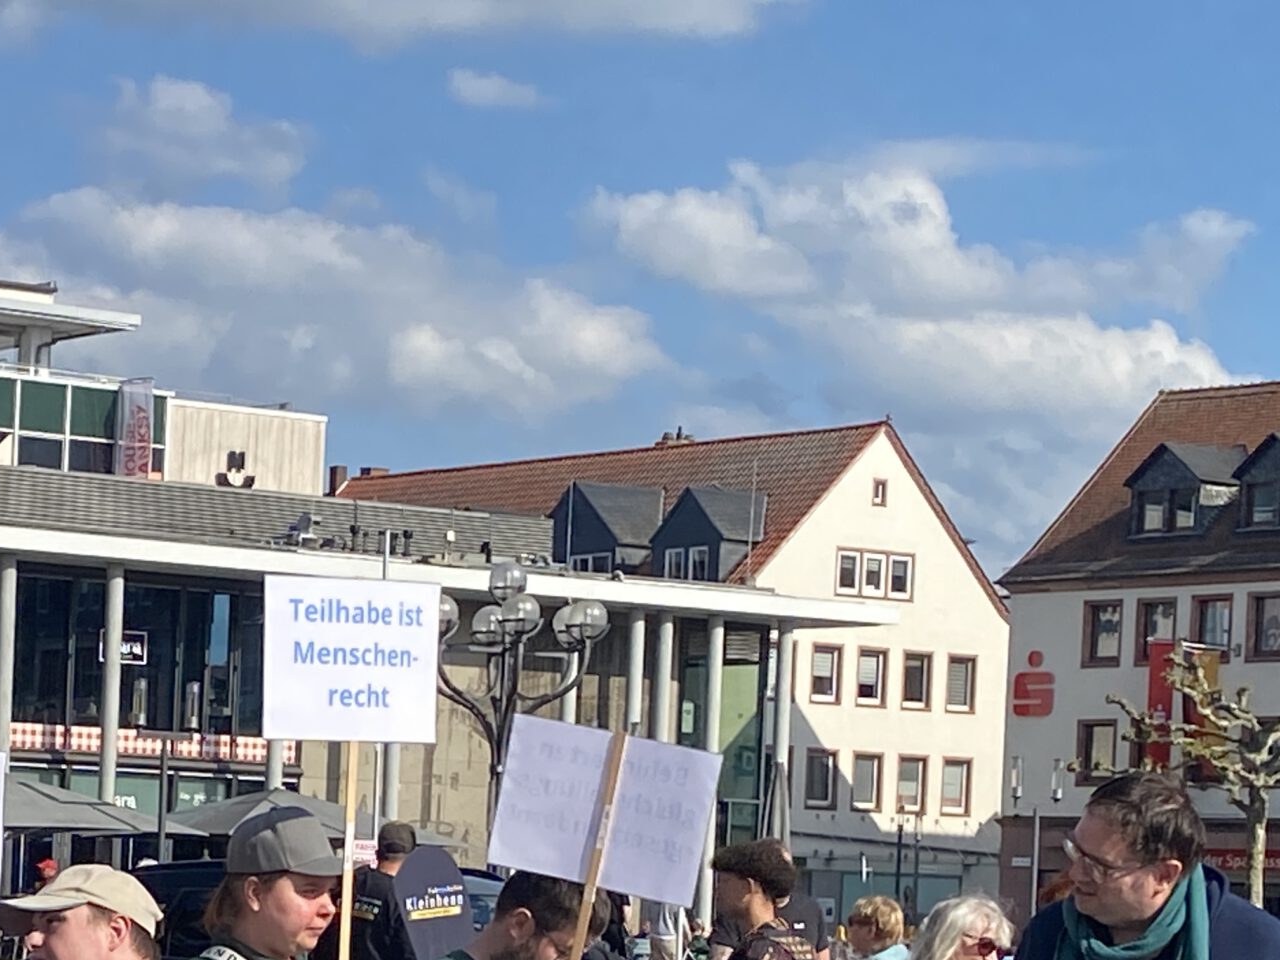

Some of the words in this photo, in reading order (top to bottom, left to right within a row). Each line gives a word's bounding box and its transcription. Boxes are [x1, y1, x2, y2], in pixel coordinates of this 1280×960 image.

[289, 598, 392, 626] Teilhabe
[398, 601, 423, 627] ist
[293, 640, 418, 668] Menschen-
[328, 683, 389, 708] recht
